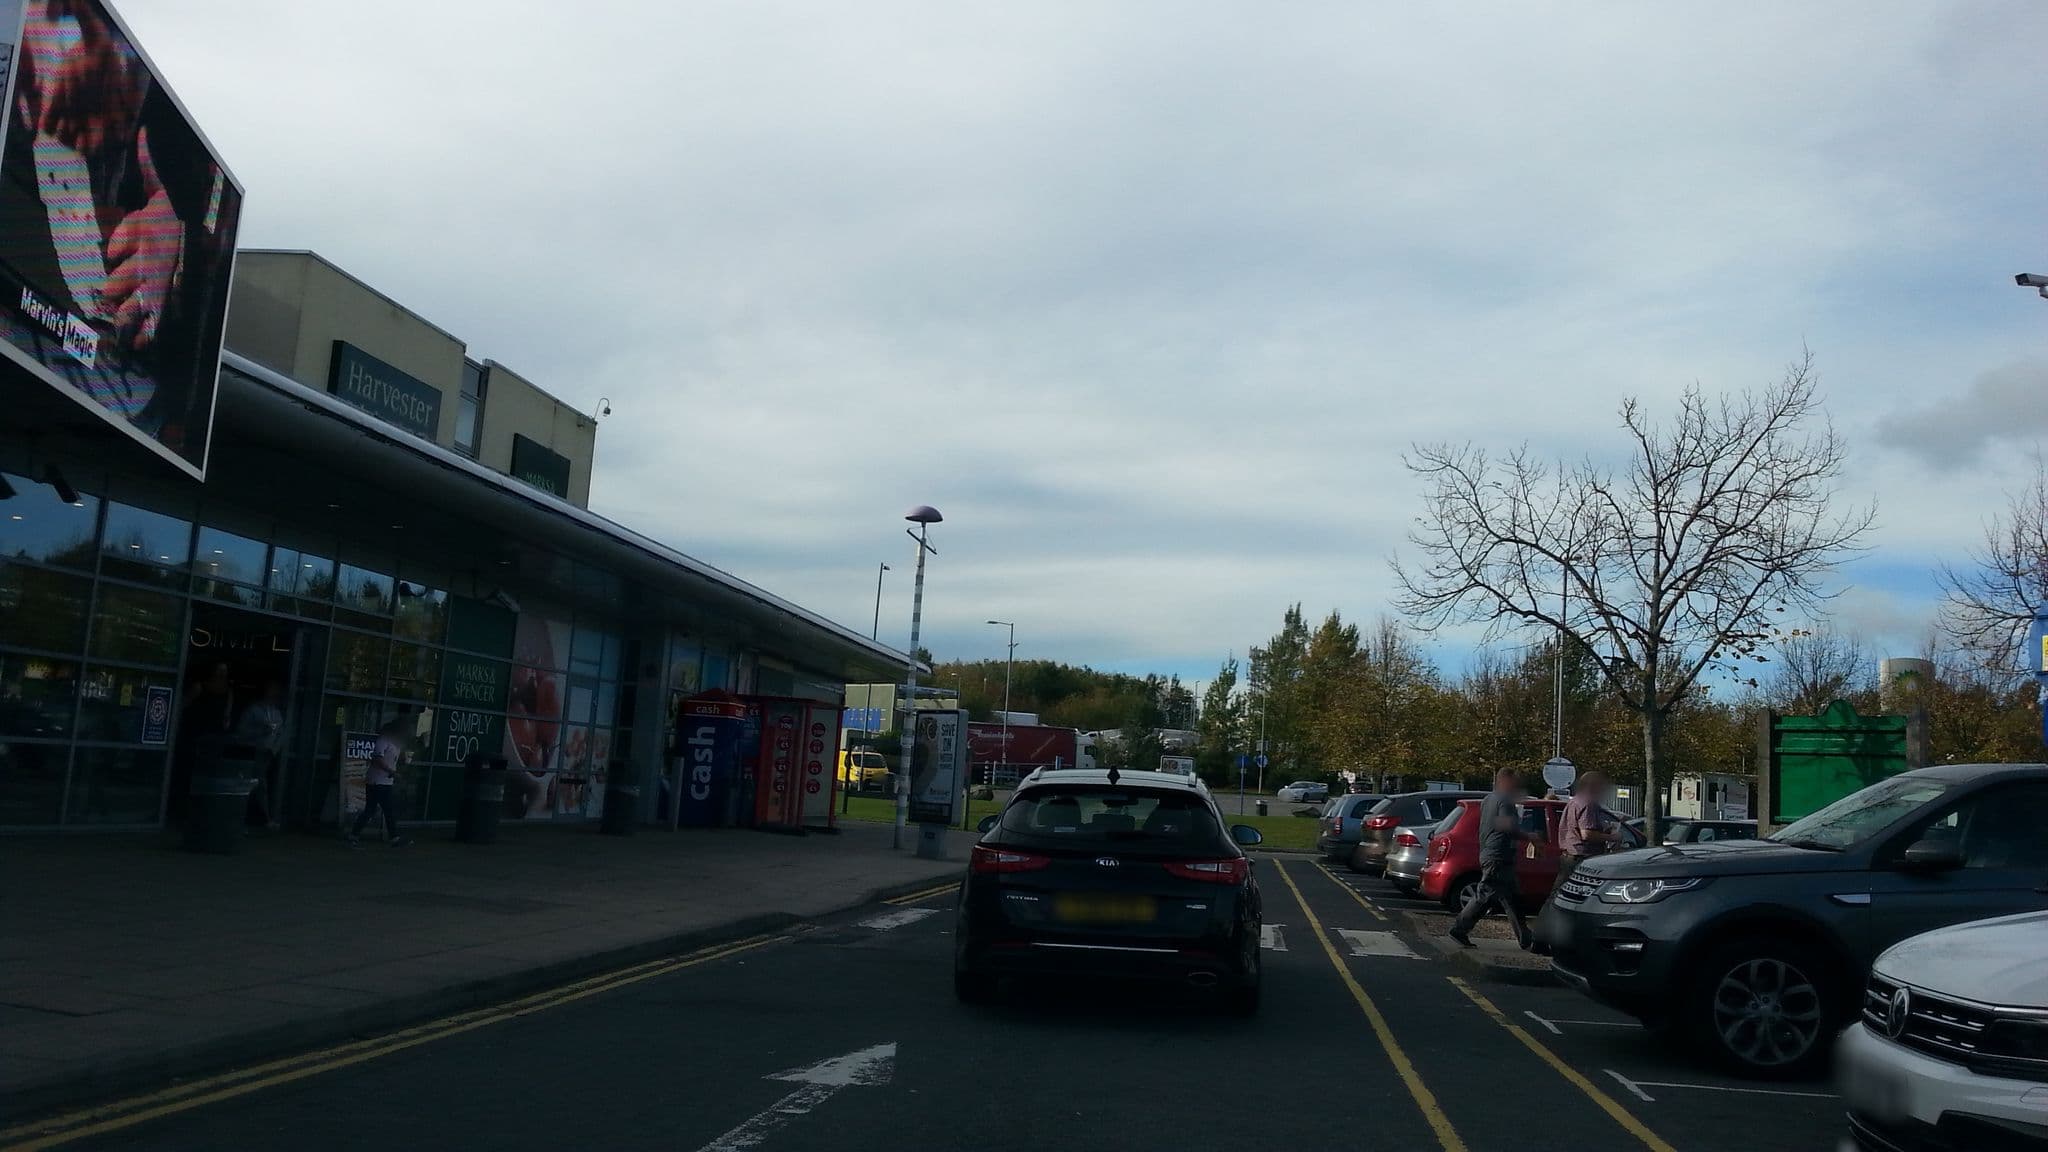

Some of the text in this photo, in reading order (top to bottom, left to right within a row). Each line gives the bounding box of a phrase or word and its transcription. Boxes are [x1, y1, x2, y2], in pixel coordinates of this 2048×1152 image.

[20, 285, 93, 358] Marvin's Magic
[347, 361, 433, 424] Harvester
[455, 681, 495, 703] SPENCER
[696, 704, 721, 714] cash
[688, 726, 716, 800] cash
[1098, 858, 1116, 867] KIA
